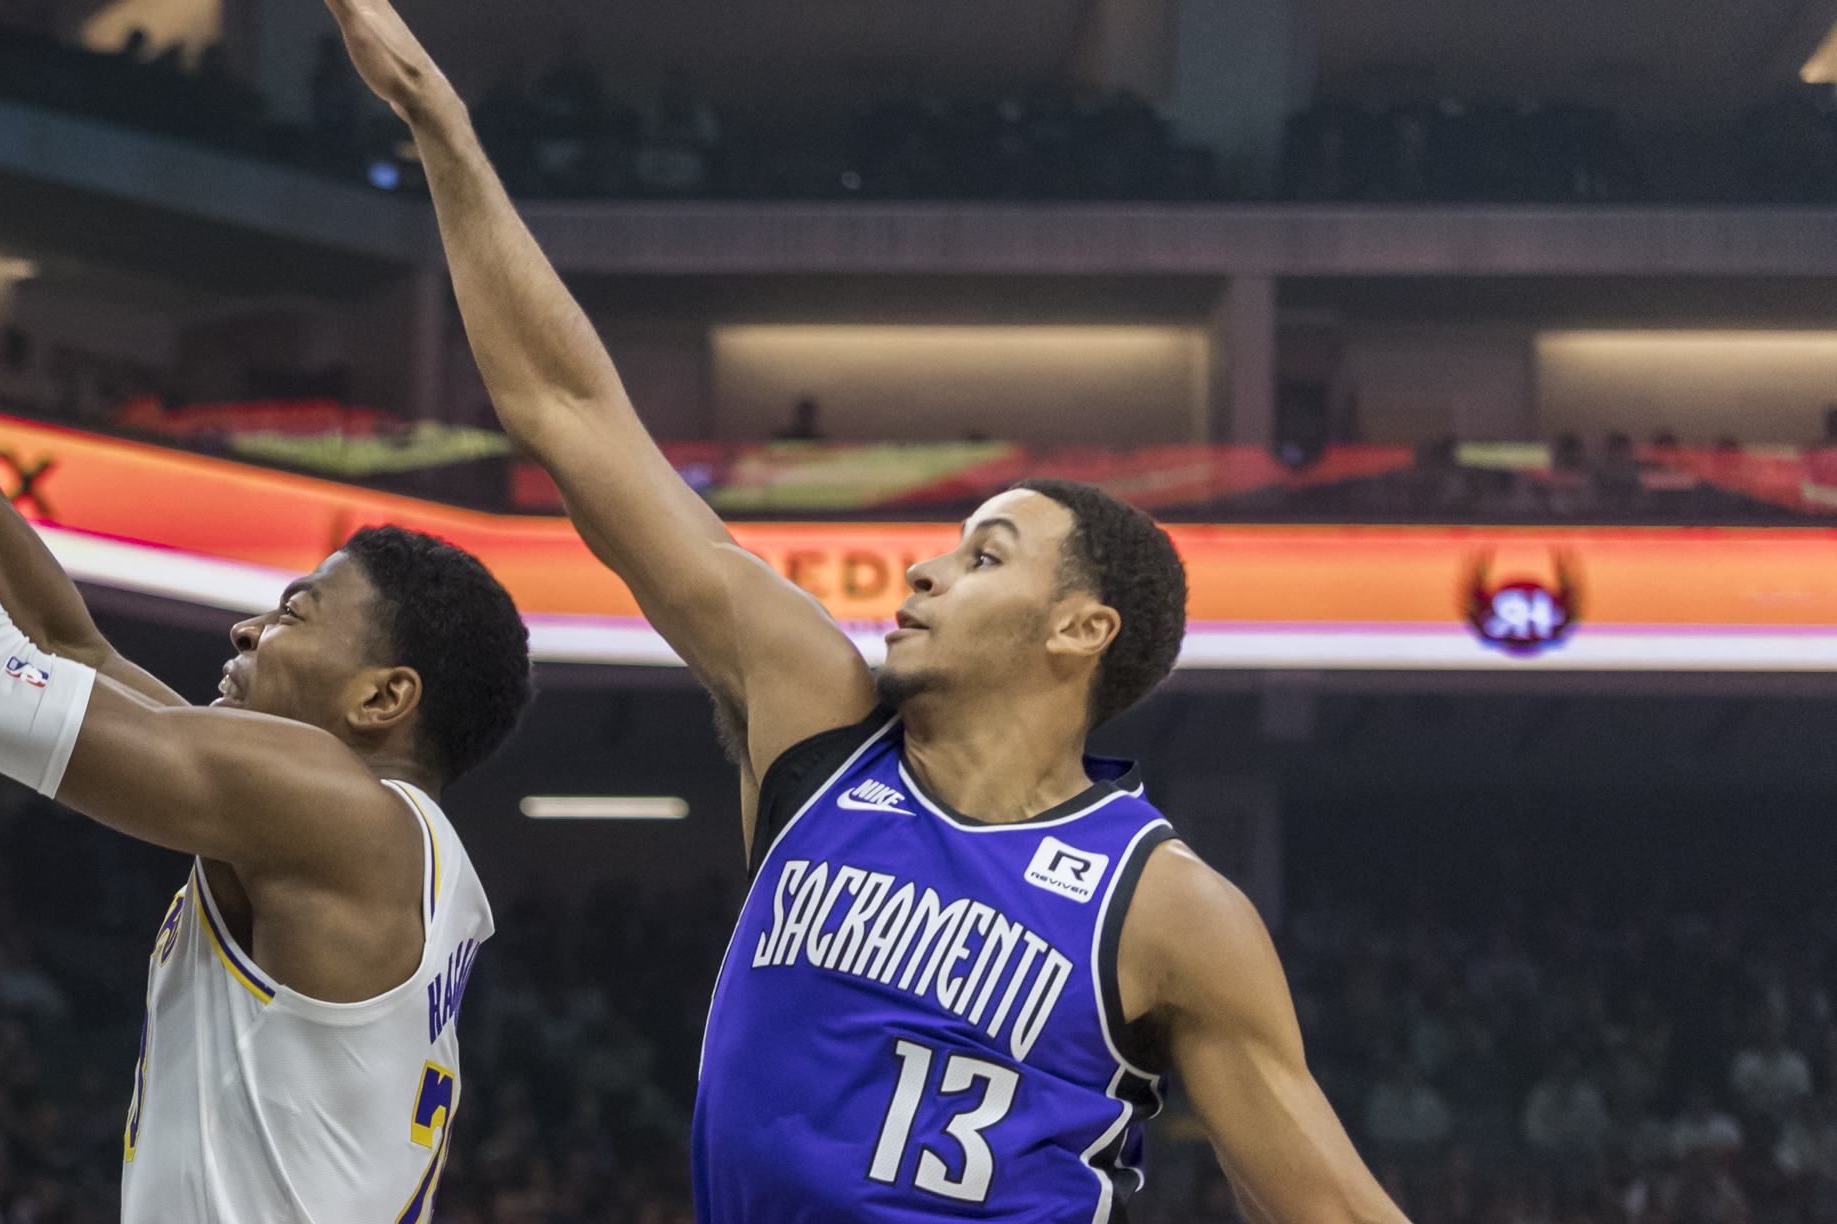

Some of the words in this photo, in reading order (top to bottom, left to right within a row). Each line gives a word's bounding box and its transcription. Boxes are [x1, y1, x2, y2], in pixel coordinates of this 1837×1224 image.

[852, 778, 906, 808] NIKE
[1030, 871, 1089, 897] REVIVER
[751, 859, 1074, 1063] SACRAMENTO
[864, 1036, 1020, 1203] 13
